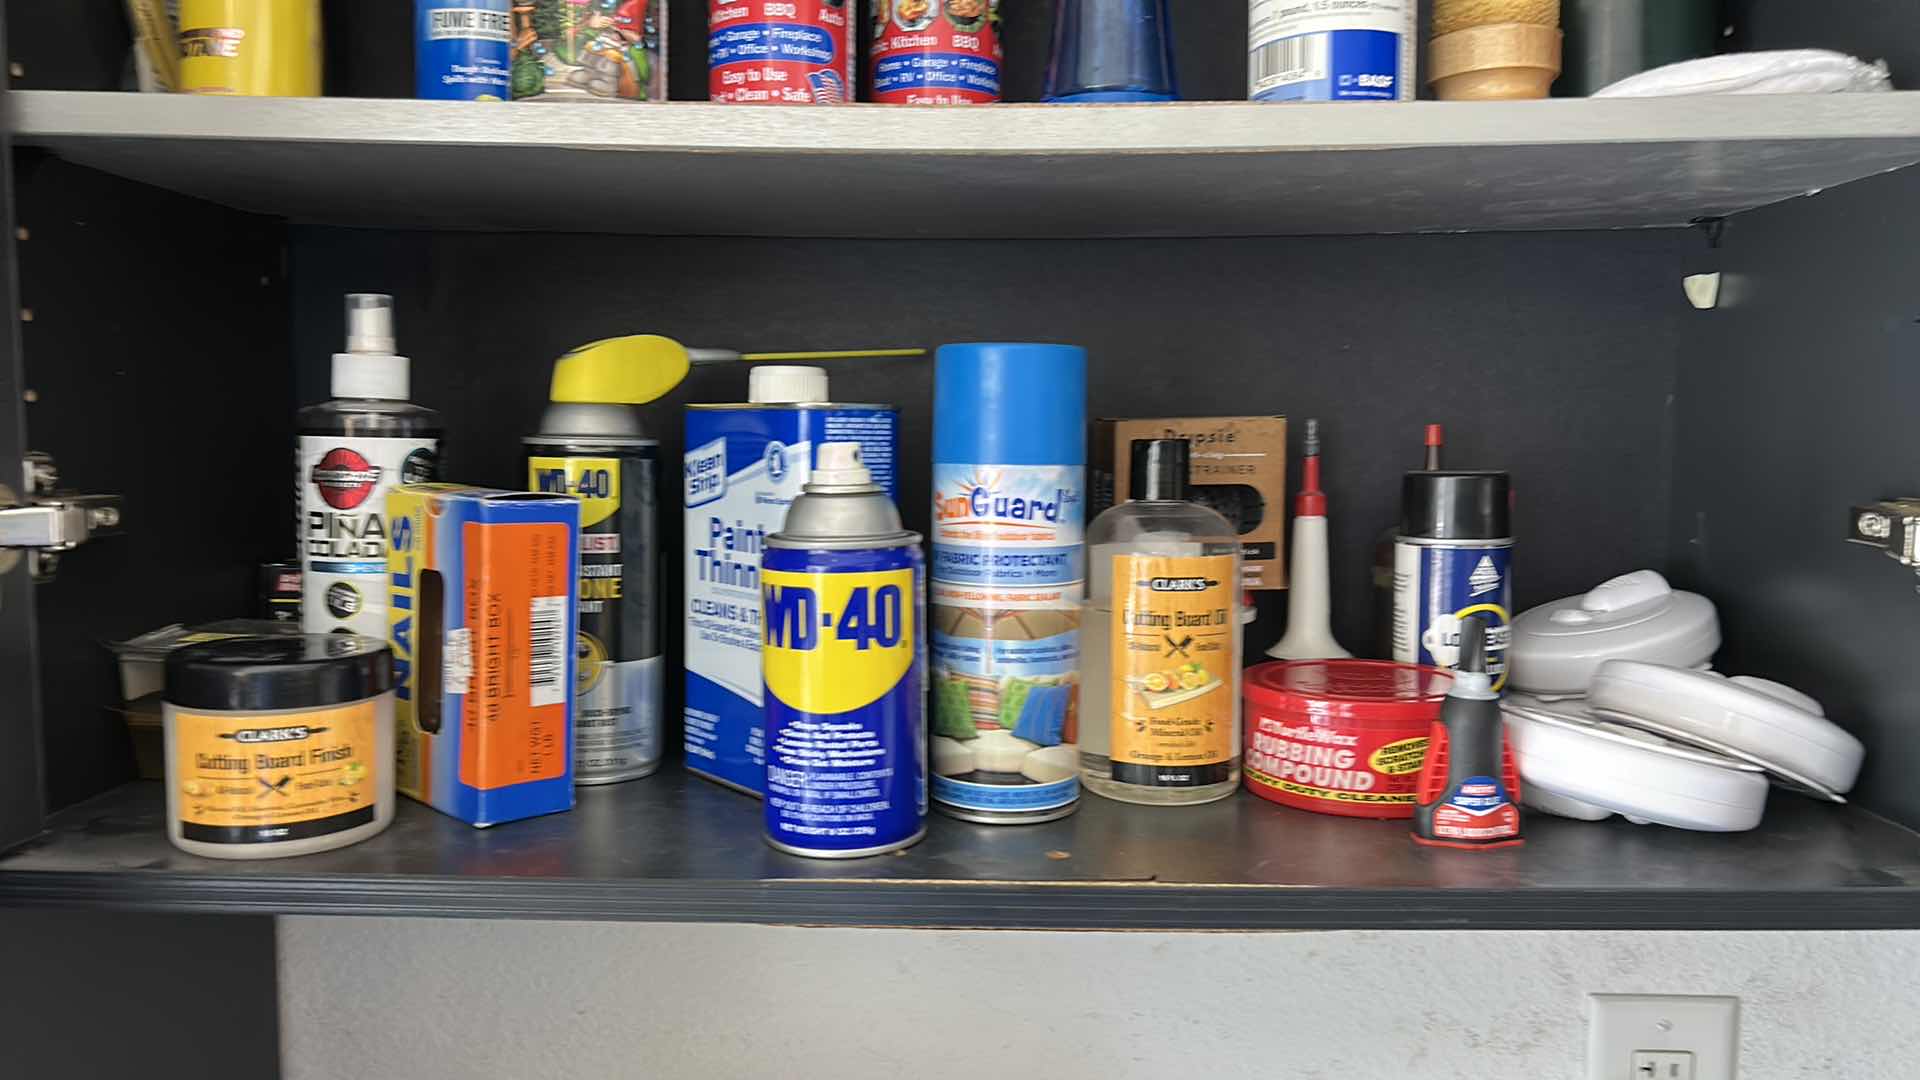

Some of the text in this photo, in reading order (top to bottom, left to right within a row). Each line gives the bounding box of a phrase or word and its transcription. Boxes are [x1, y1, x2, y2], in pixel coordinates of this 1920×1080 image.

[432, 11, 475, 28] FUME
[764, 3, 797, 18] BBQ
[890, 34, 938, 49] Kitchen
[952, 35, 980, 51] BBQ
[747, 69, 761, 82] to
[762, 67, 788, 81] Use
[1358, 74, 1394, 88] BASF
[735, 87, 769, 101] Clean
[782, 87, 812, 102] Safe
[686, 453, 723, 477] Klean
[536, 466, 609, 499] WD-40
[710, 516, 767, 554] Paint
[1152, 579, 1206, 590] CLARK'S
[391, 514, 413, 702] NAILS
[487, 592, 501, 628] BOX
[691, 598, 738, 621] CLEANS
[763, 582, 904, 651] WD-40
[1175, 609, 1212, 627] Board
[487, 635, 501, 697] BRIGHT
[237, 727, 307, 742] CLARK'S
[195, 744, 353, 775] Cutting Board Finish
[1252, 731, 1356, 770] RUBBING
[1246, 747, 1376, 791] COMPOUND
[1282, 781, 1331, 797] DUTY
